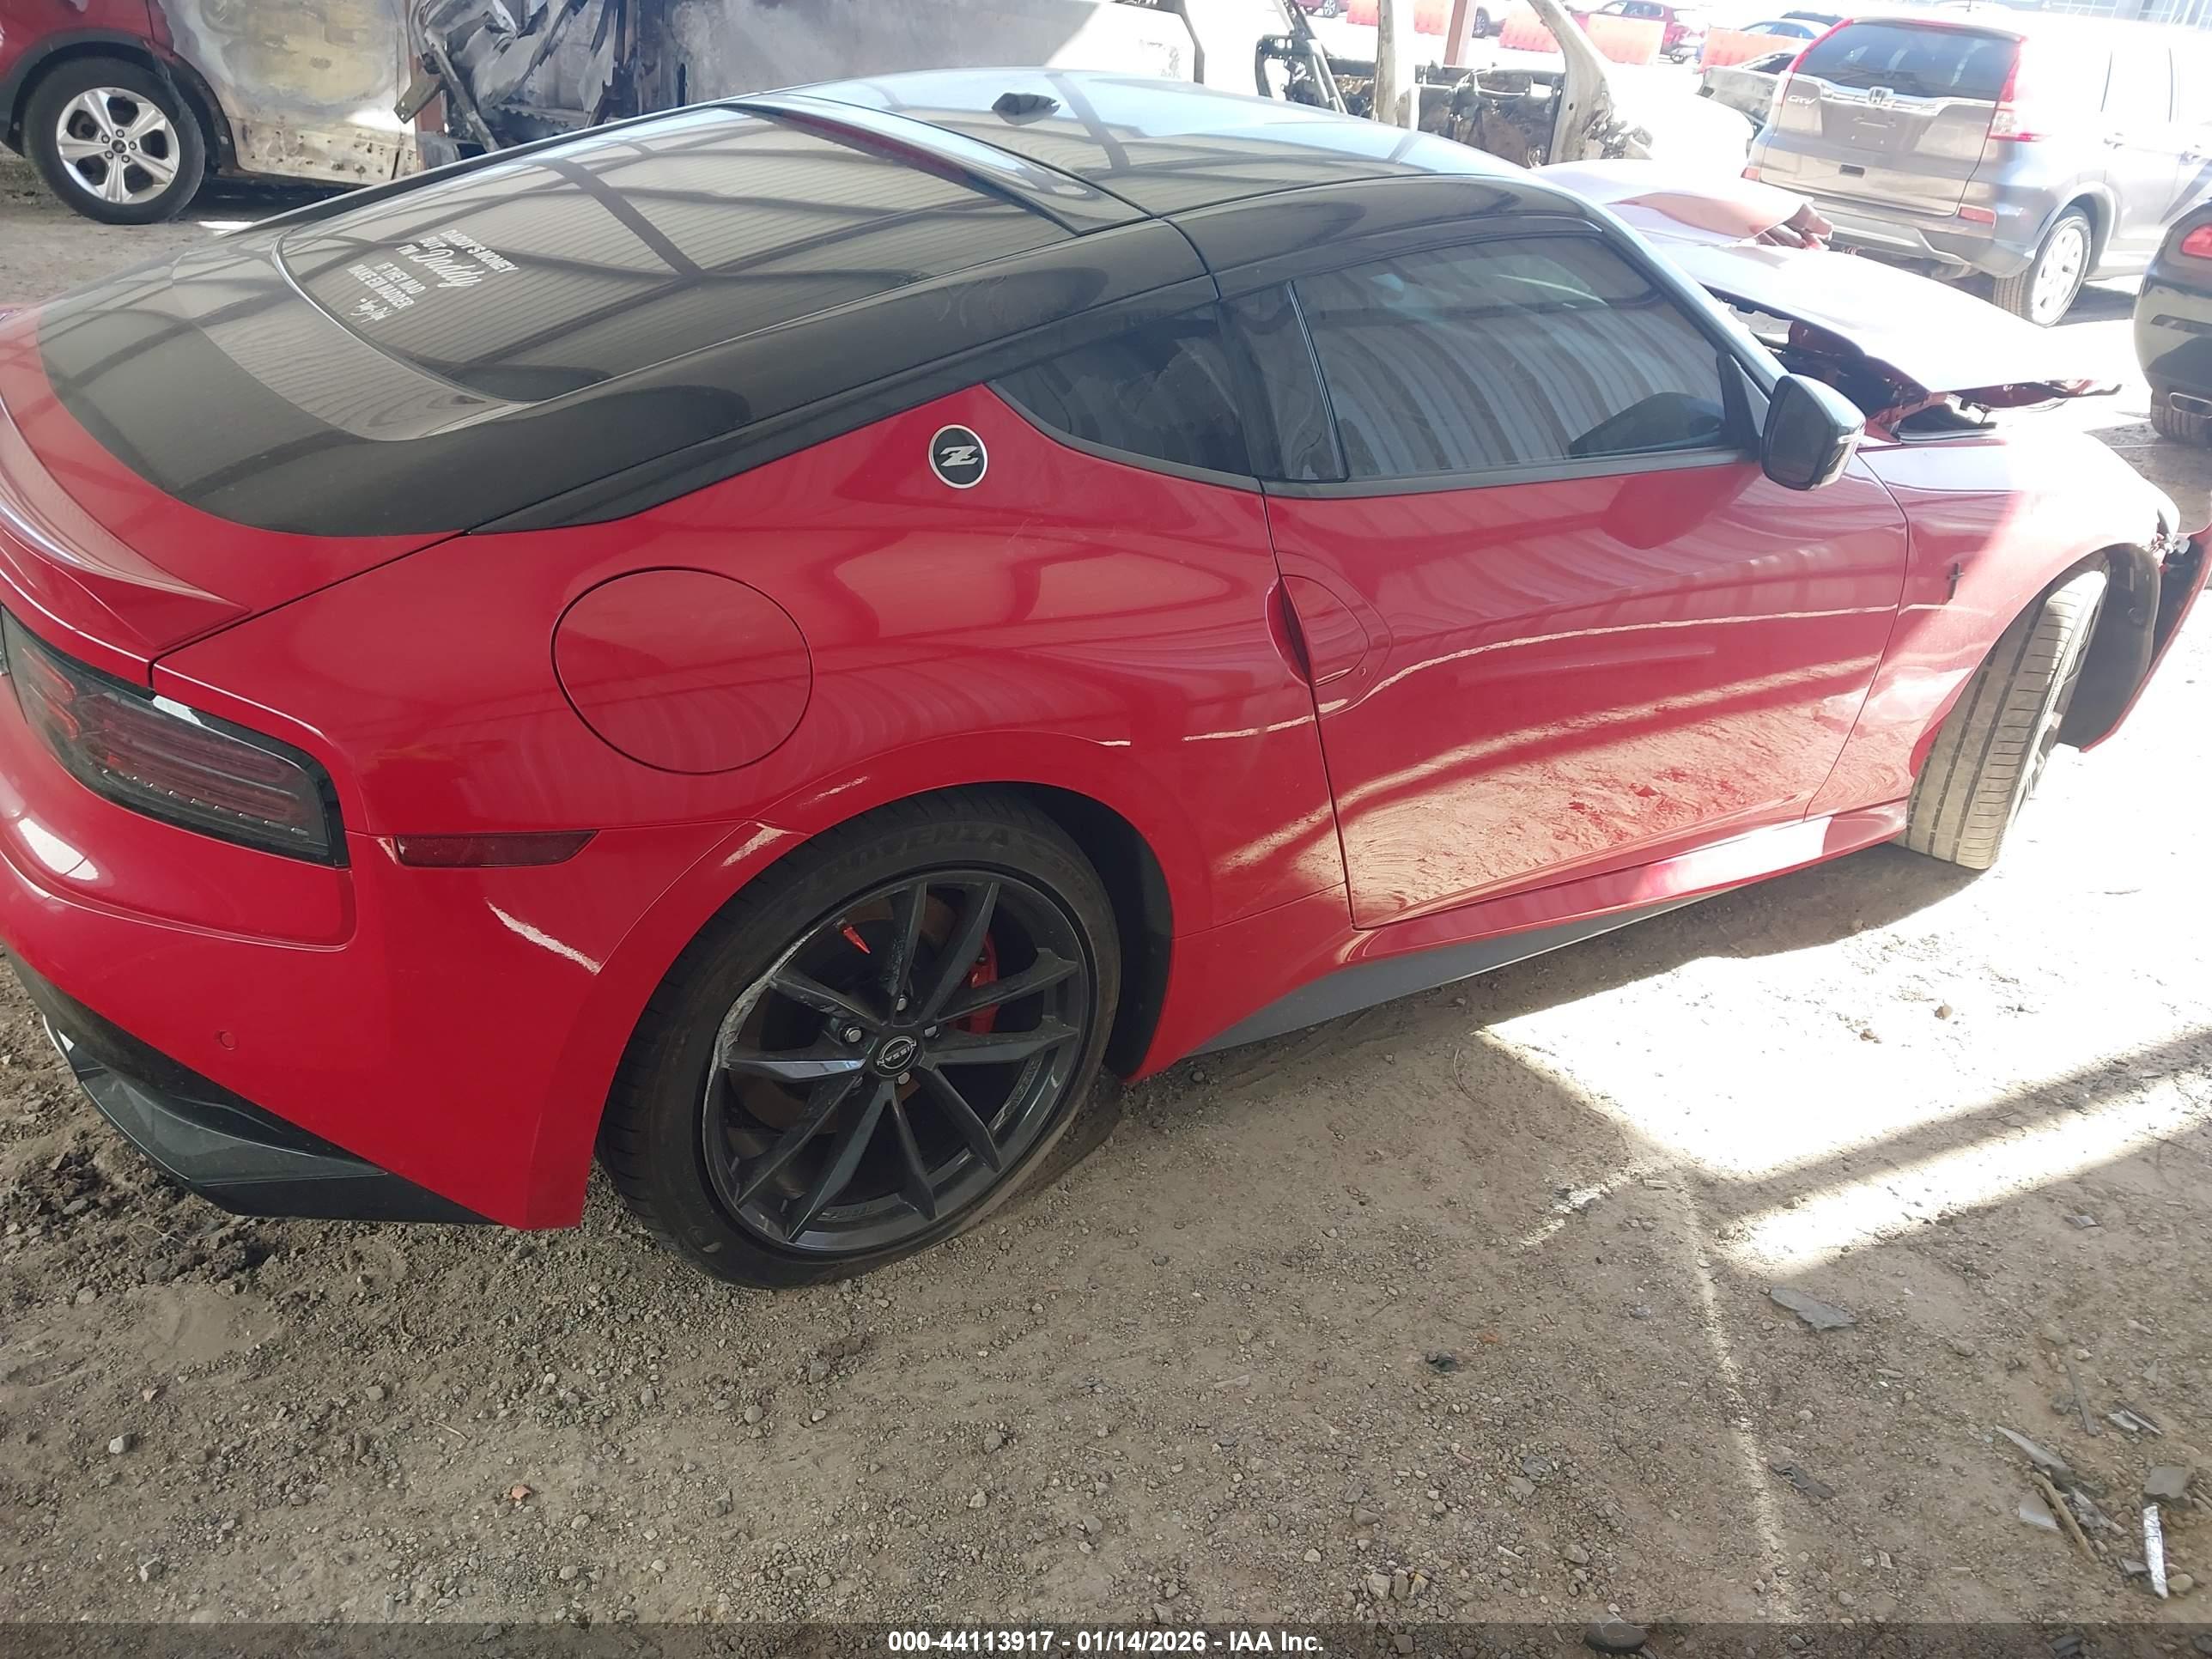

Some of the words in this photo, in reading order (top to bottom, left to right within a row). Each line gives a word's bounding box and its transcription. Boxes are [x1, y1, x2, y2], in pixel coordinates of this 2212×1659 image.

[419, 236, 447, 250] BUT
[374, 262, 394, 272] IF
[409, 249, 486, 288] Daddy
[473, 250, 520, 273] MONEY
[382, 266, 412, 283] THEY
[346, 264, 379, 282] MAKE
[374, 283, 415, 309] MADDER
[398, 279, 427, 295] MAD
[876, 1039, 917, 1066] NISSAN
